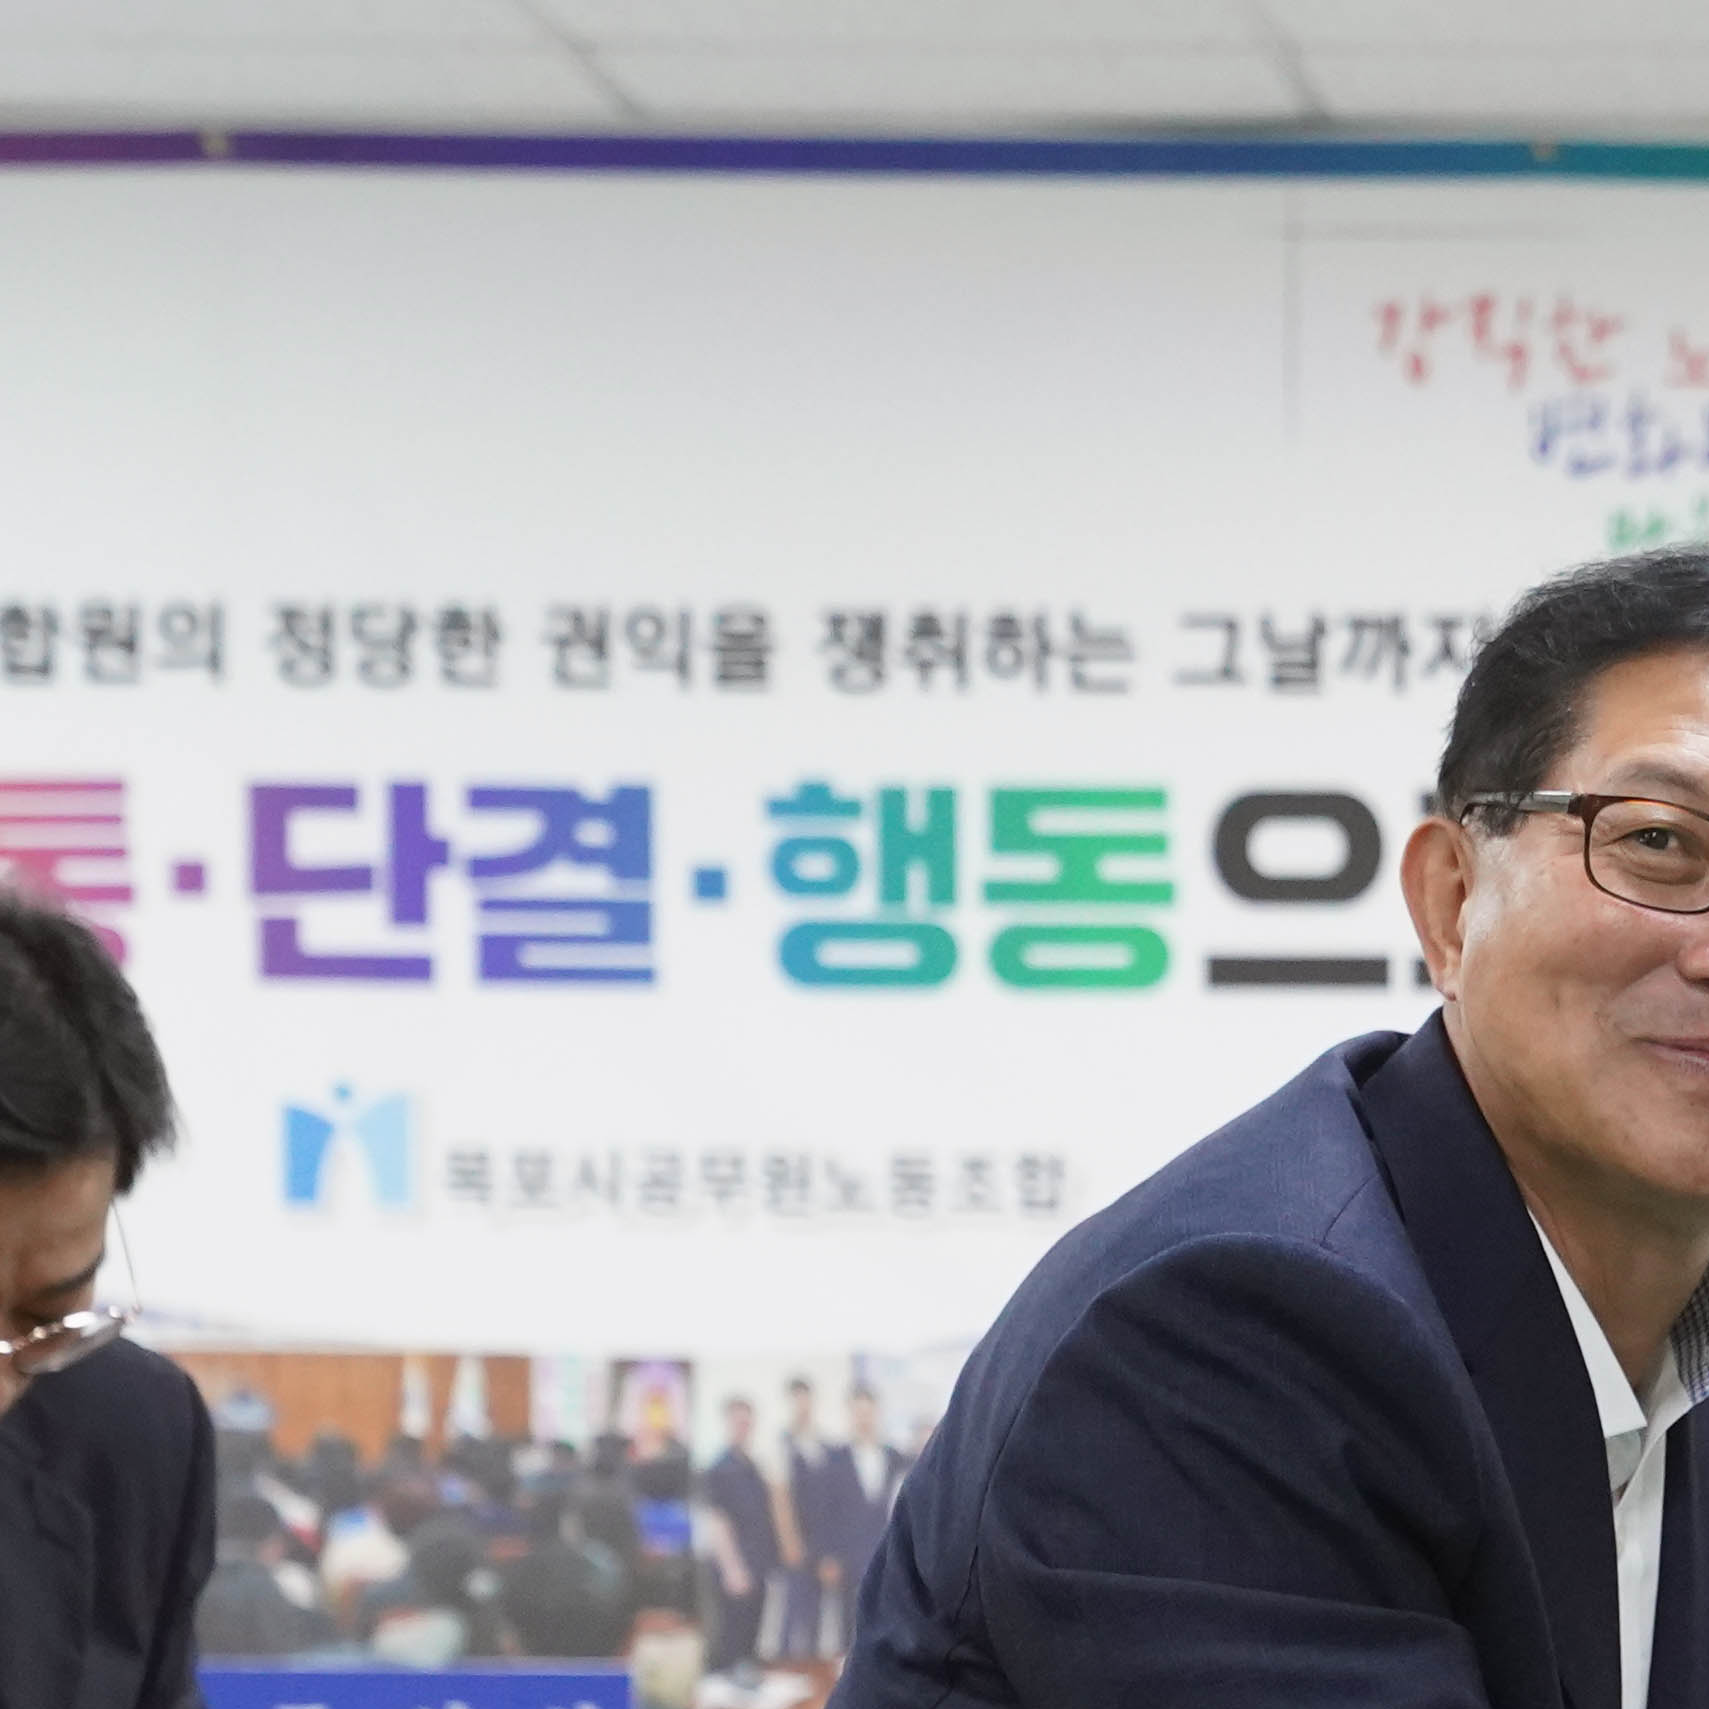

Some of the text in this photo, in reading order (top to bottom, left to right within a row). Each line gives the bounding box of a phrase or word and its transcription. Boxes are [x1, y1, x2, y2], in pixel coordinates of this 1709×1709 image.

[271, 602, 504, 687] 정당한
[547, 605, 775, 690] 권익을
[822, 608, 1131, 692] 쟁취하는
[0, 778, 1438, 988] ·단결·행동으
